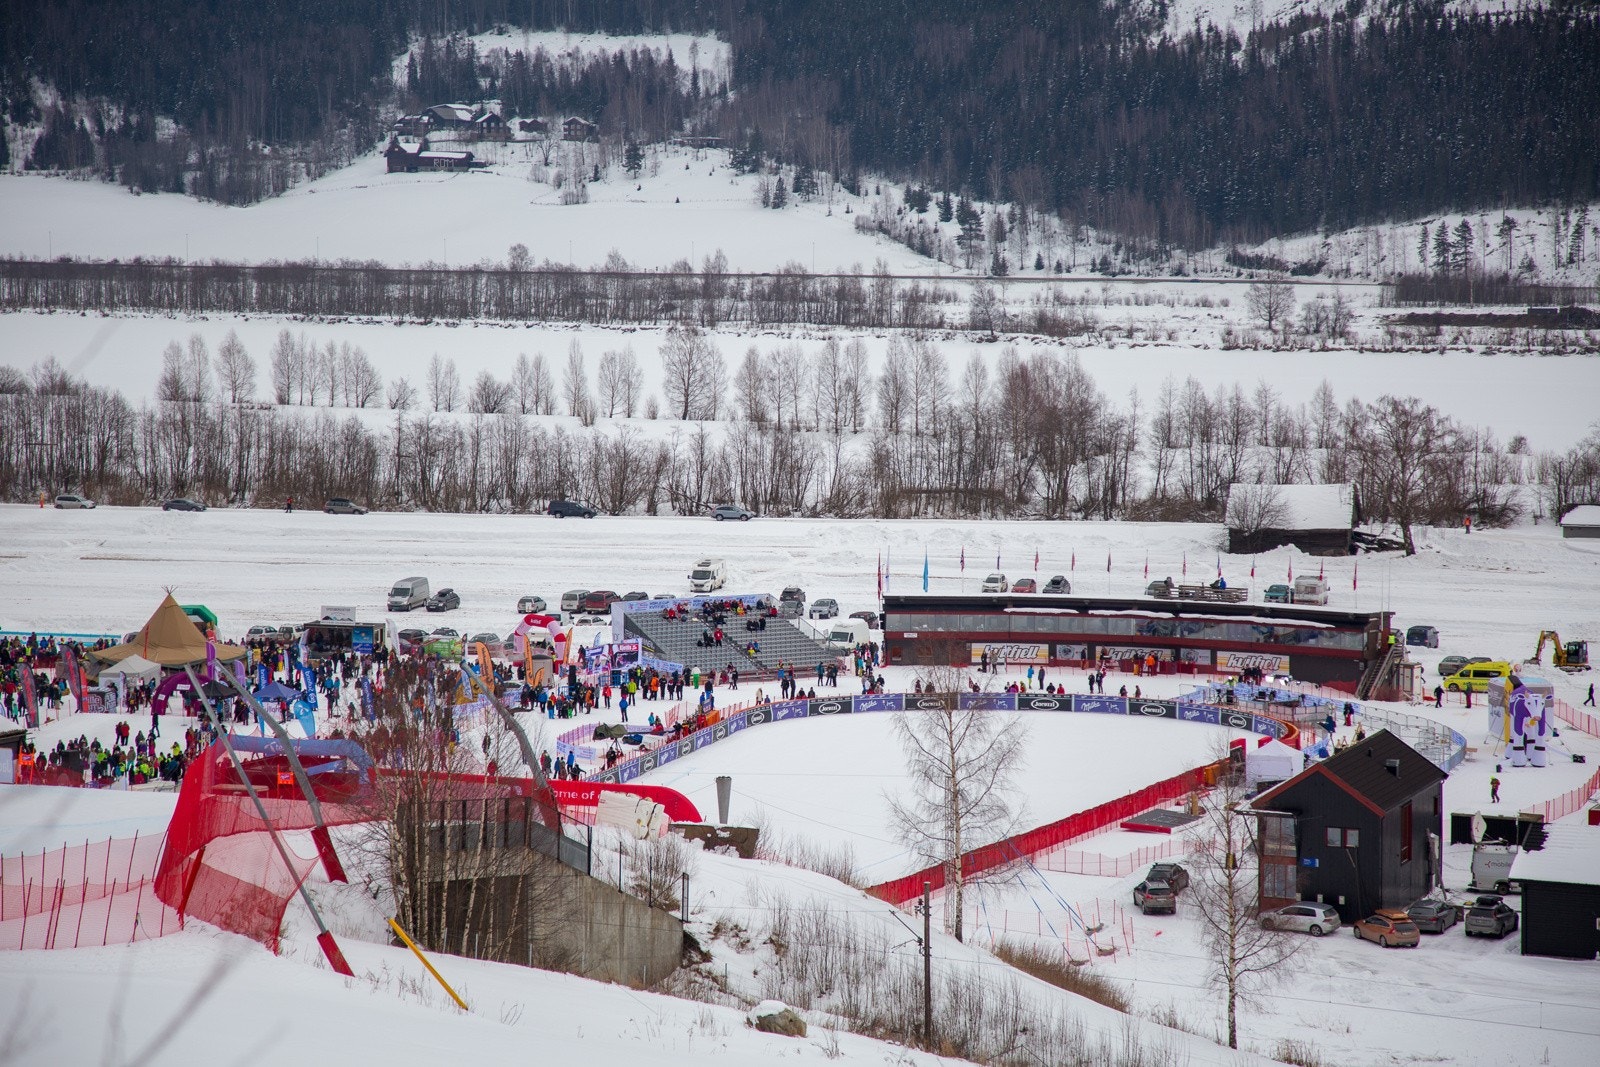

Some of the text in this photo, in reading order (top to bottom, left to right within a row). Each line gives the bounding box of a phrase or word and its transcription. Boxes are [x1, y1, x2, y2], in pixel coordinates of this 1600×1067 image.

[1080, 701, 1101, 712] Milka
[554, 789, 579, 800] ome
[581, 790, 596, 800] of
